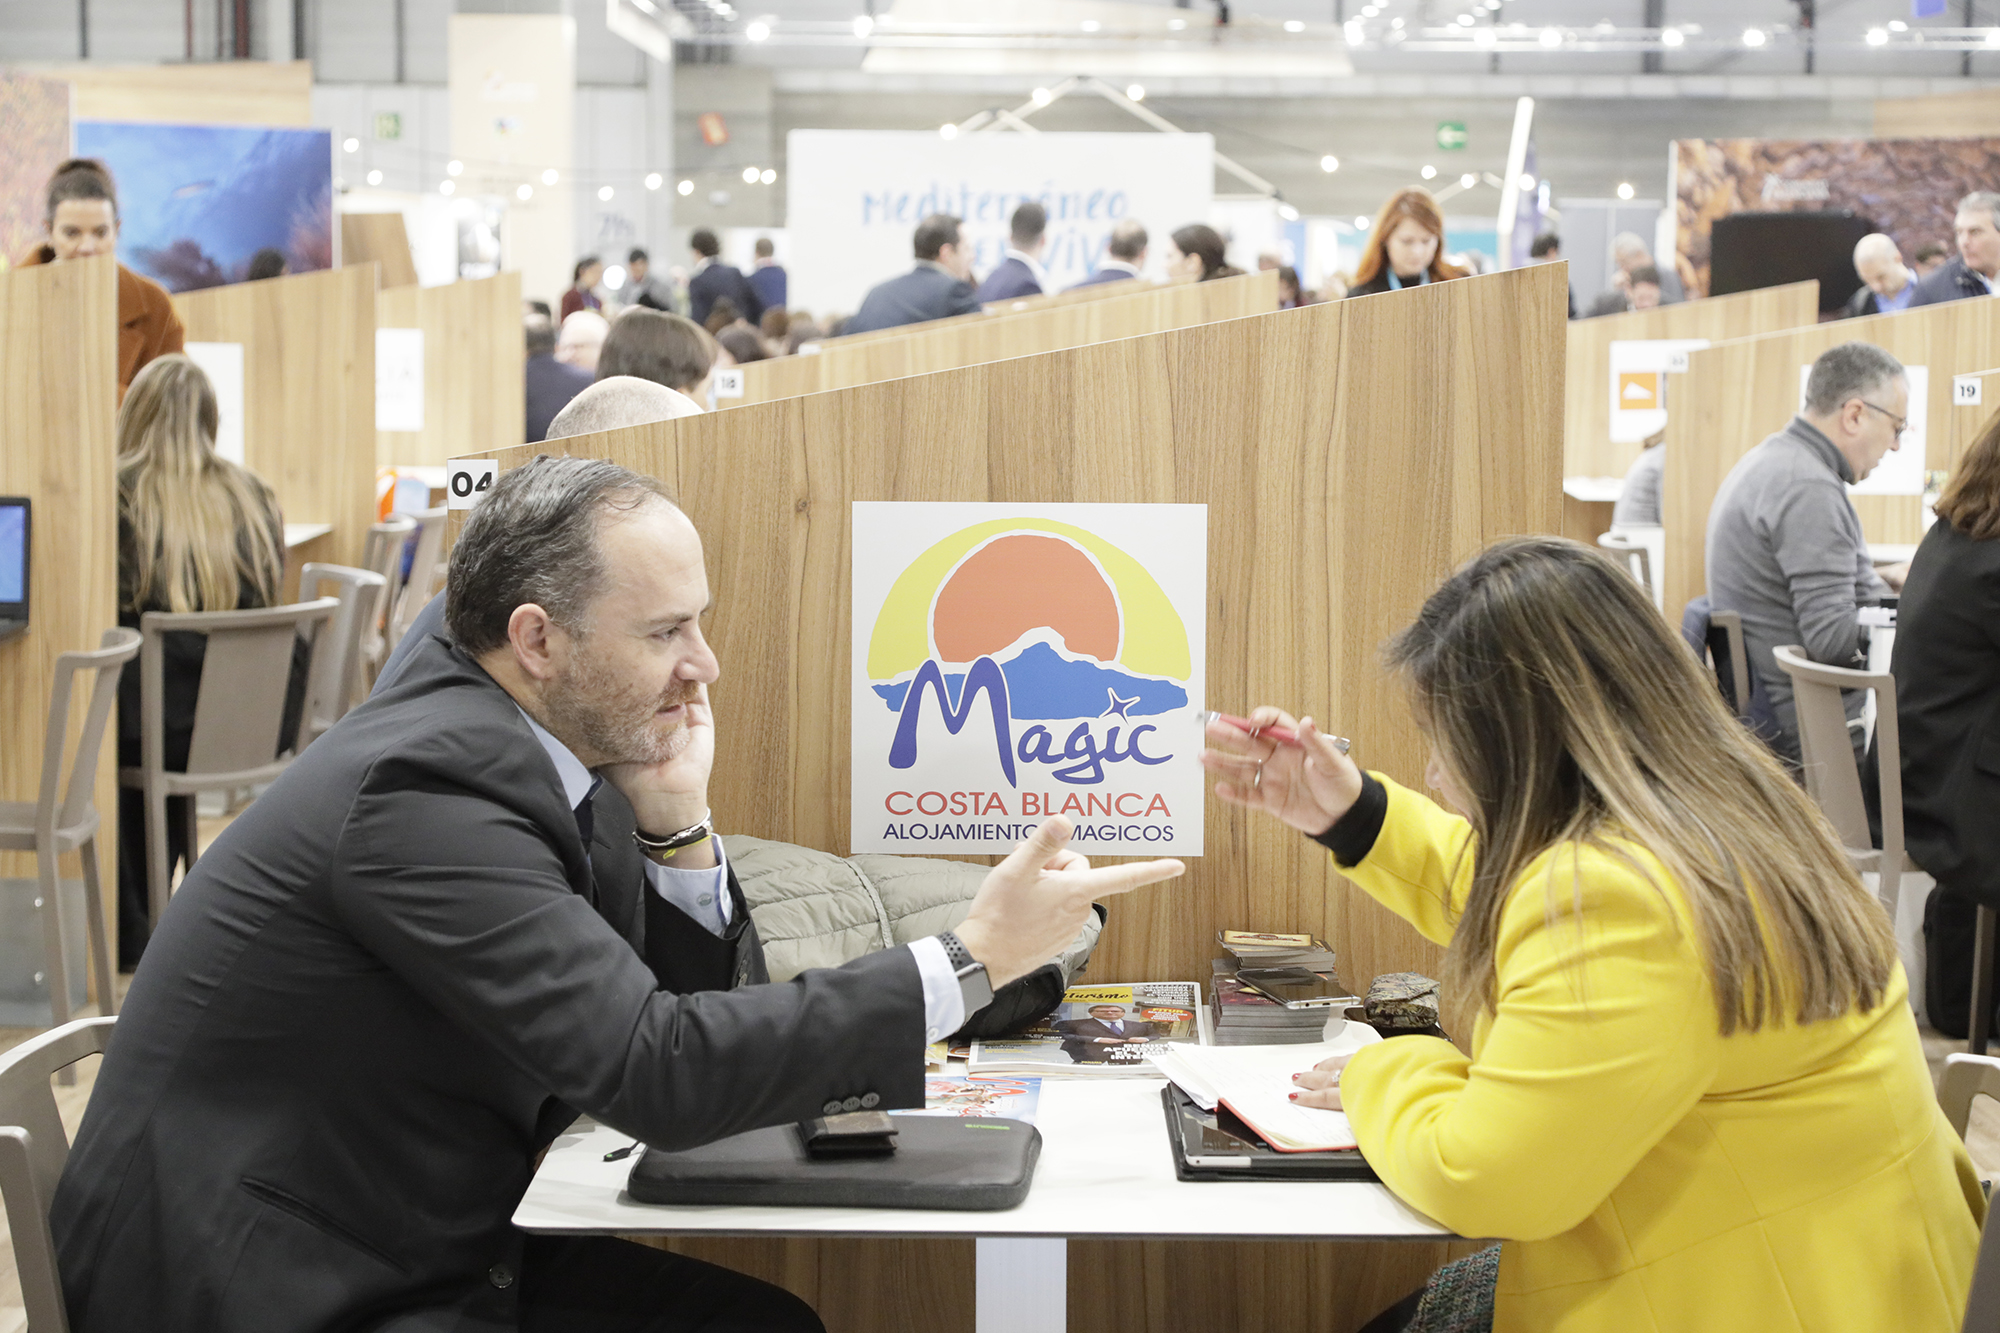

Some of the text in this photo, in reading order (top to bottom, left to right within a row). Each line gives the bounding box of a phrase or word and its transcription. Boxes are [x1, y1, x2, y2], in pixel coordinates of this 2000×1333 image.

[1959, 385, 1976, 397] 19
[451, 471, 492, 497] 04
[888, 656, 1174, 788] Magic
[884, 791, 1172, 817] COSTA BLANCA
[883, 823, 1038, 841] ALOJAMIENTO
